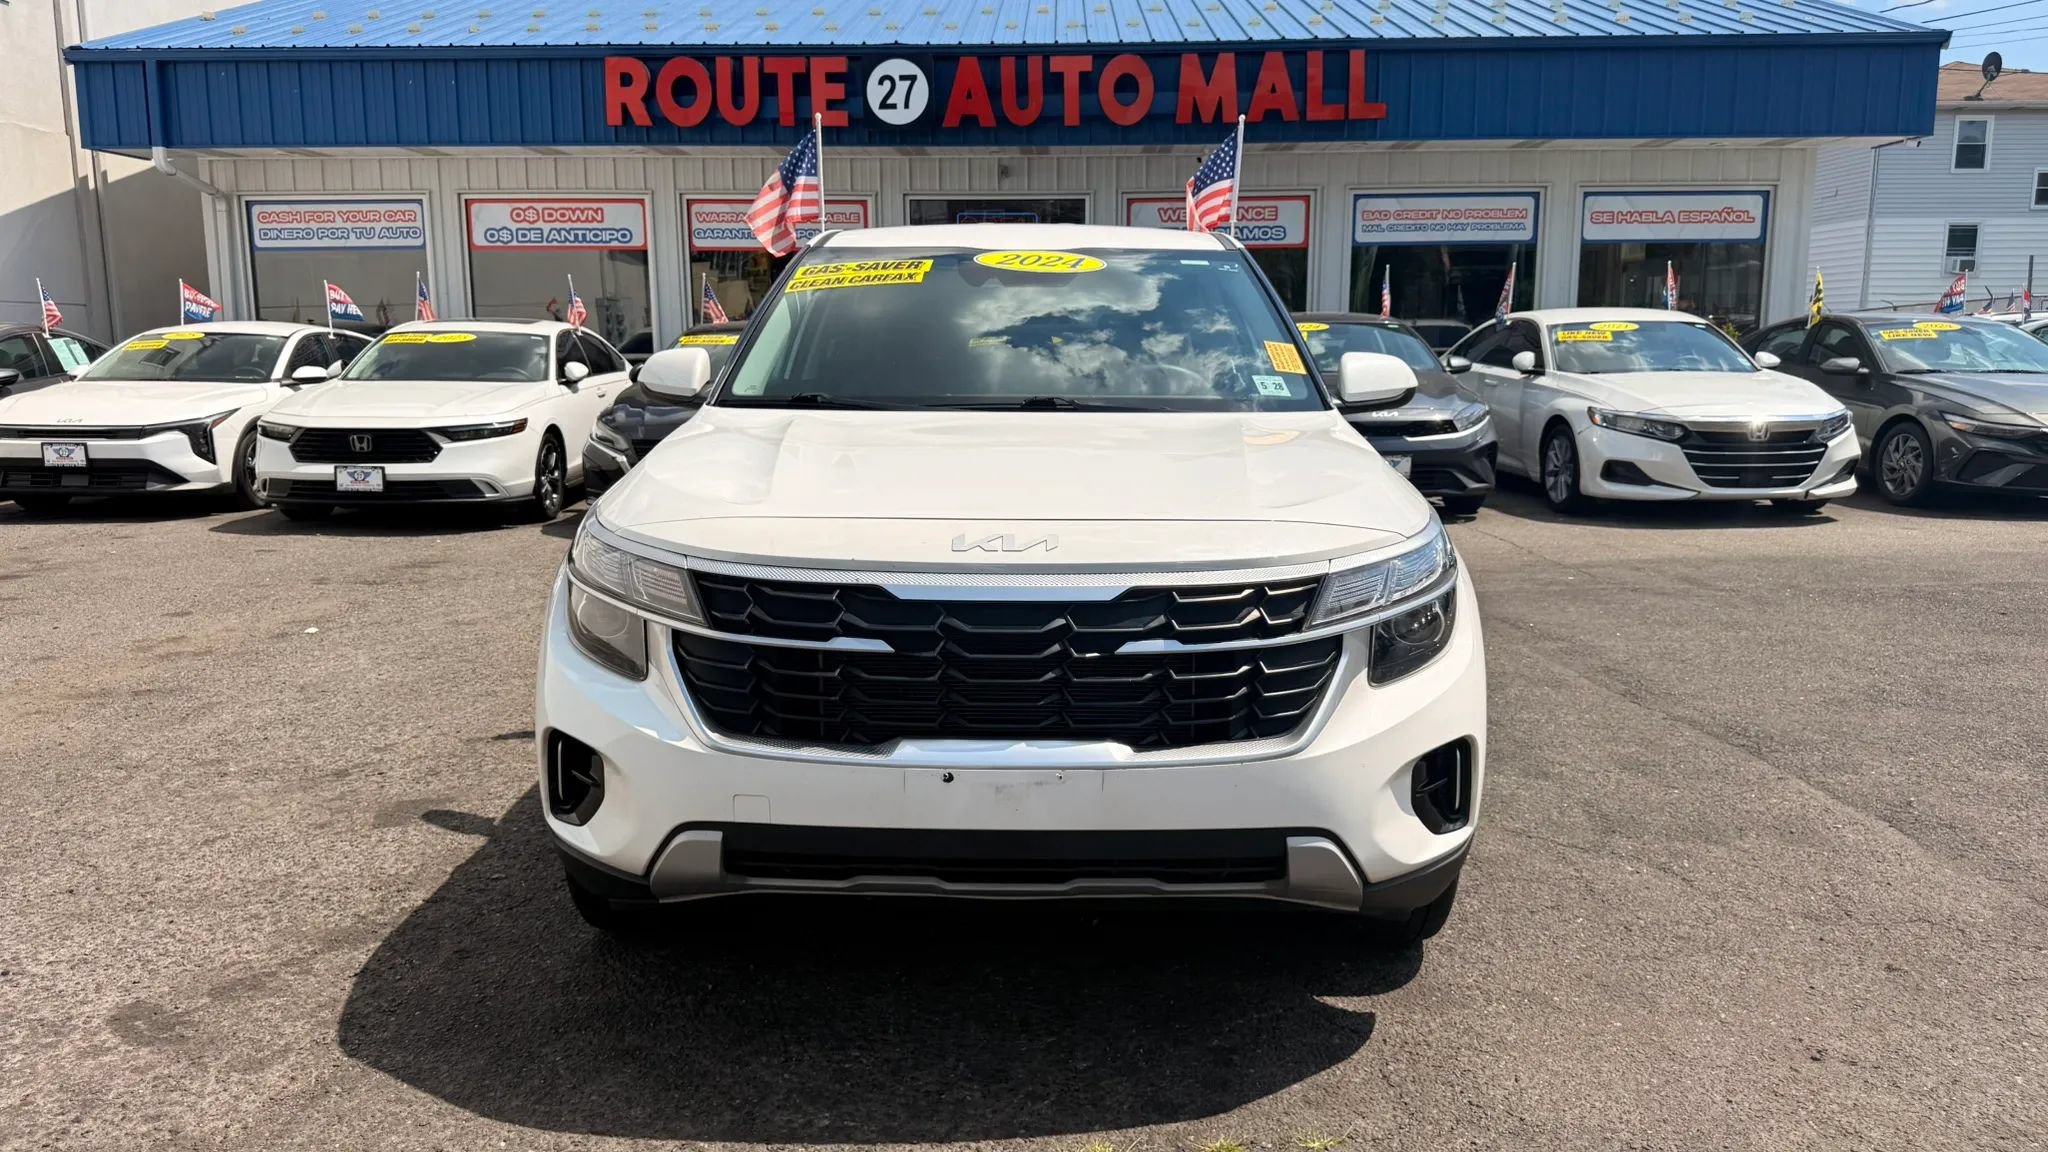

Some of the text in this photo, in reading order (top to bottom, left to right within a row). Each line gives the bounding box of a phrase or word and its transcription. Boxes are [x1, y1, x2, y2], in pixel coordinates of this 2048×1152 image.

[604, 49, 1387, 129] ROUTE 27 AUTO MALL
[257, 210, 417, 224] CASH FOR YOUR CAR
[541, 207, 604, 223] DOWN
[695, 211, 748, 224] WARRA
[1361, 208, 1528, 221] BAD CREDIT NO PROBLEM
[1590, 206, 1756, 224] SE HABLA ESPAÑOL
[259, 226, 422, 241] DINERO POR TU AUTO
[1361, 222, 1527, 233] MAL CREDITO NO HAY PROBLEMA
[516, 228, 543, 243] DE
[545, 228, 633, 244] ANTICIPO
[801, 261, 923, 276] GAS-SAVER
[994, 253, 1087, 270] 2024
[789, 271, 919, 290] CLEAN CARFAX
[1260, 381, 1268, 390] 5
